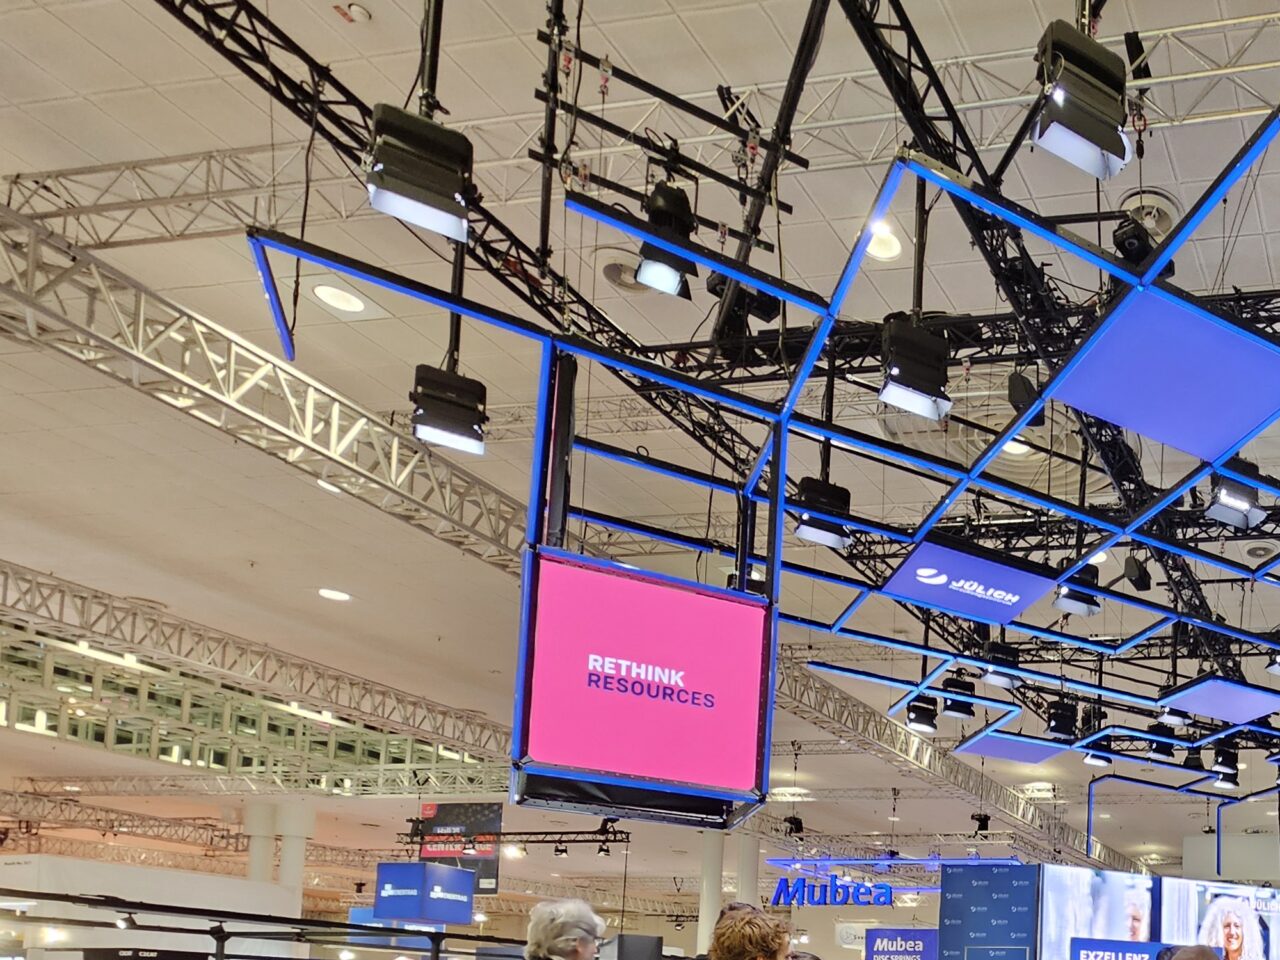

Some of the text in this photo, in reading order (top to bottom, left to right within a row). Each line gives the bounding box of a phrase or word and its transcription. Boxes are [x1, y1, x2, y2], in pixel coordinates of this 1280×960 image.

[951, 578, 1021, 603] JÜLICH
[588, 654, 685, 687] RETHINK
[587, 672, 715, 708] RESOURCES
[771, 874, 893, 906] Mubea
[873, 937, 924, 952] Mubea
